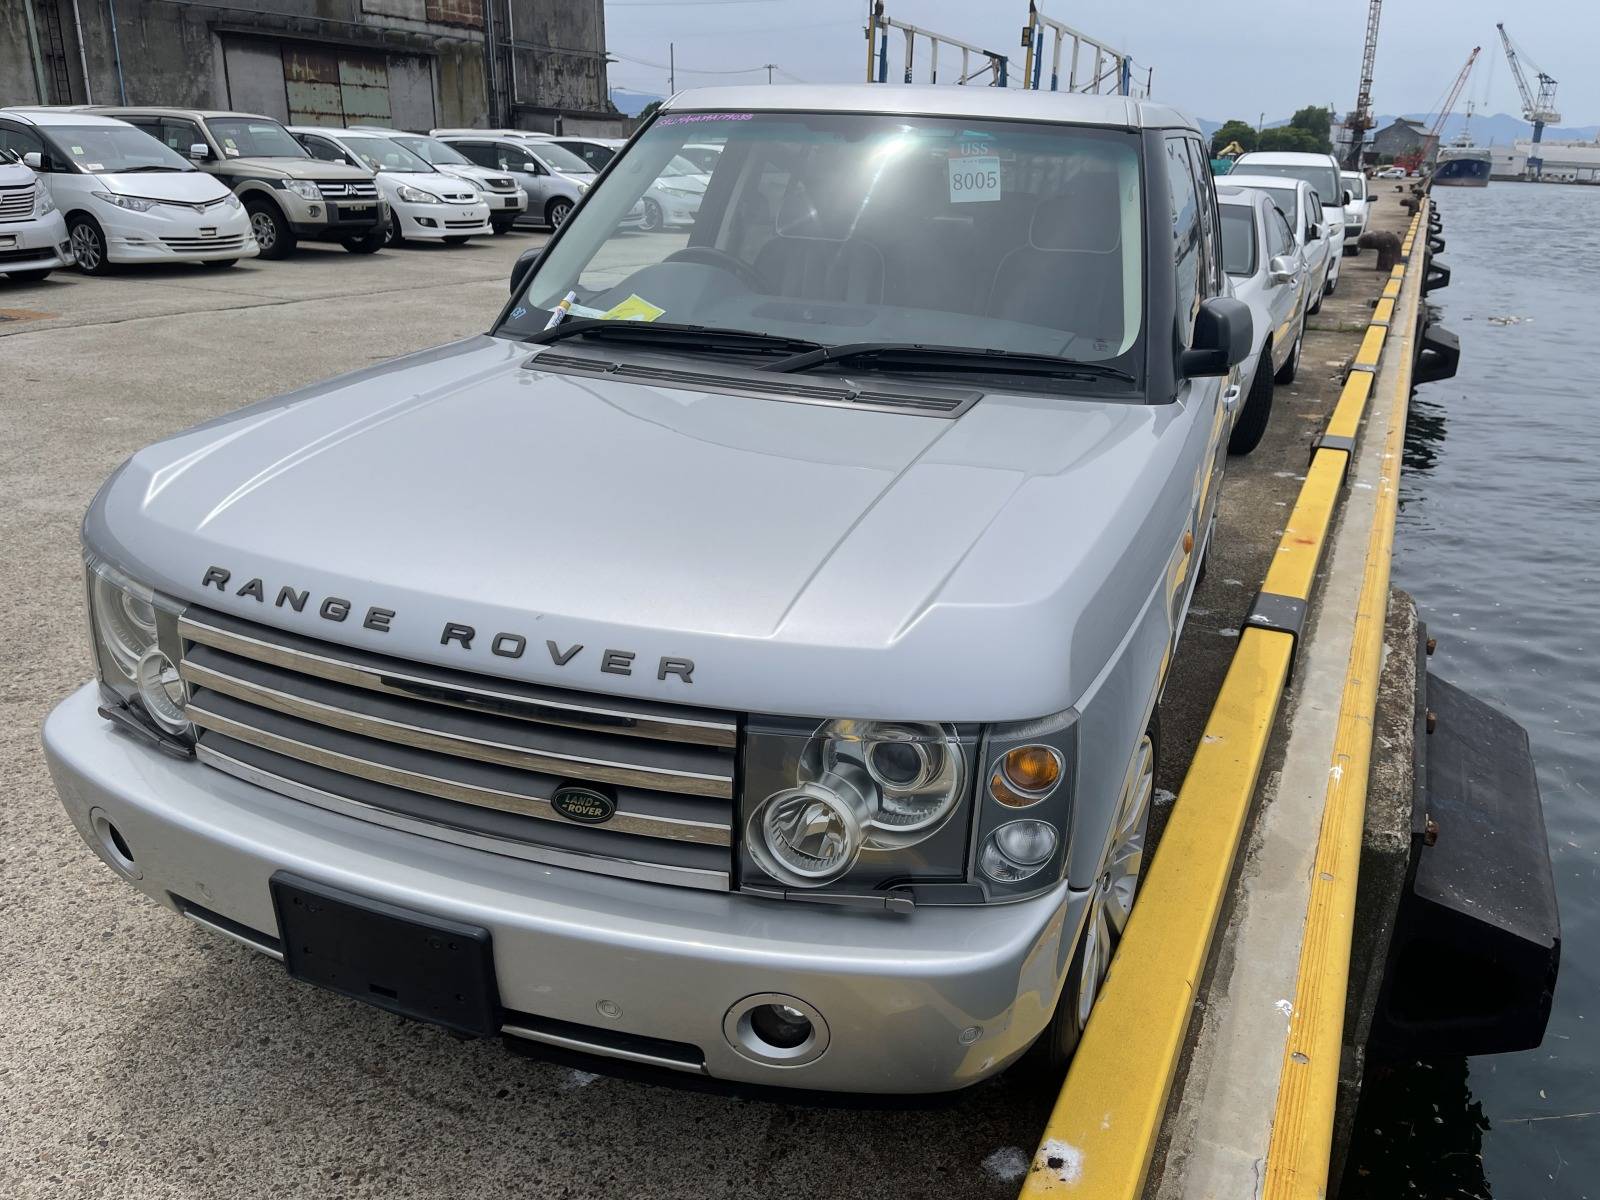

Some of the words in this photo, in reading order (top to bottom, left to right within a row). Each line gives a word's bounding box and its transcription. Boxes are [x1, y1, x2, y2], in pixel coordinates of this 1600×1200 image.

[961, 142, 989, 156] USS
[953, 171, 997, 191] 8005
[201, 565, 396, 633] RANGE
[440, 622, 695, 684] ROVER
